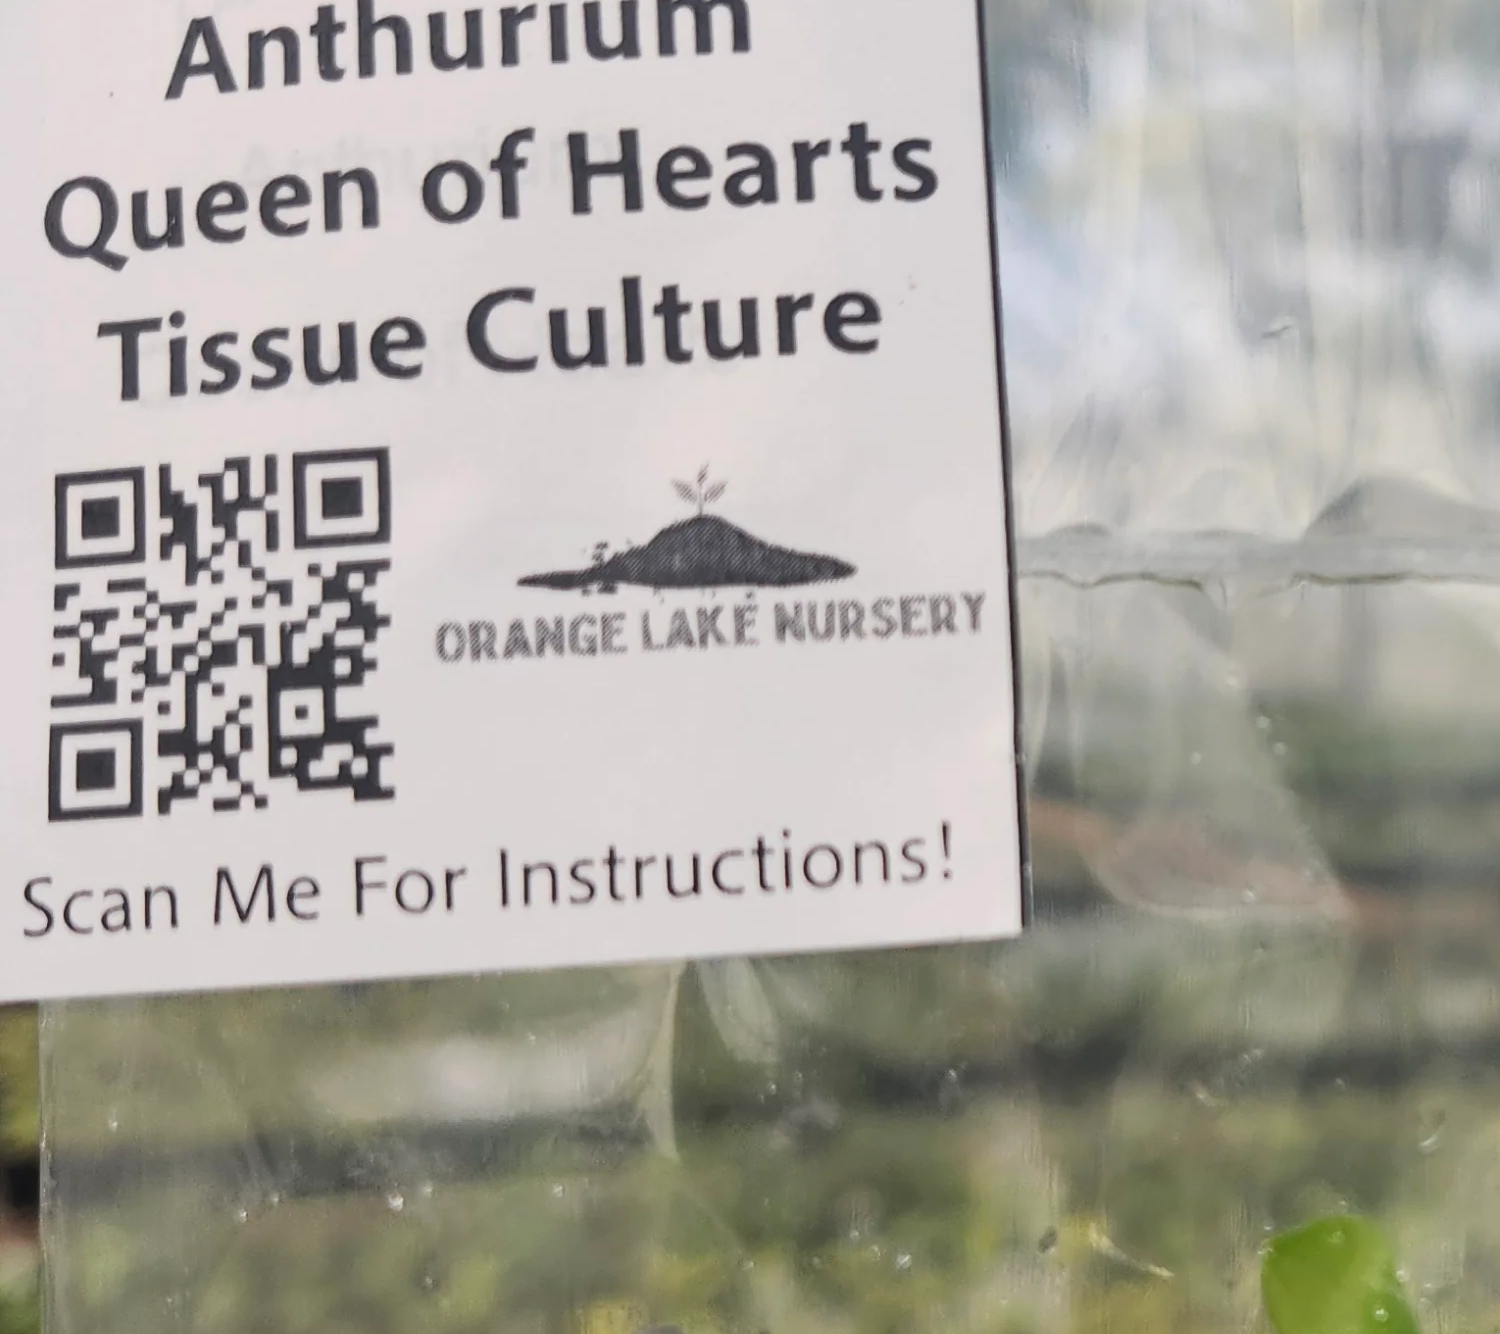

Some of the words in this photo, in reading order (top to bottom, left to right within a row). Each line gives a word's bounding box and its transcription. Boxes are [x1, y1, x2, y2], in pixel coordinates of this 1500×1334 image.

[43, 166, 380, 272] Queen
[420, 127, 535, 224] of
[566, 122, 939, 215] Hearts
[97, 311, 427, 402] Tissue
[465, 276, 882, 373] Culture
[434, 611, 628, 664] ORANGE
[641, 601, 759, 652] LAKE
[773, 591, 986, 644] NURSERY
[22, 875, 180, 939] Scan
[212, 863, 321, 926] Me
[353, 855, 467, 917] For
[499, 820, 951, 908] Instructions!
